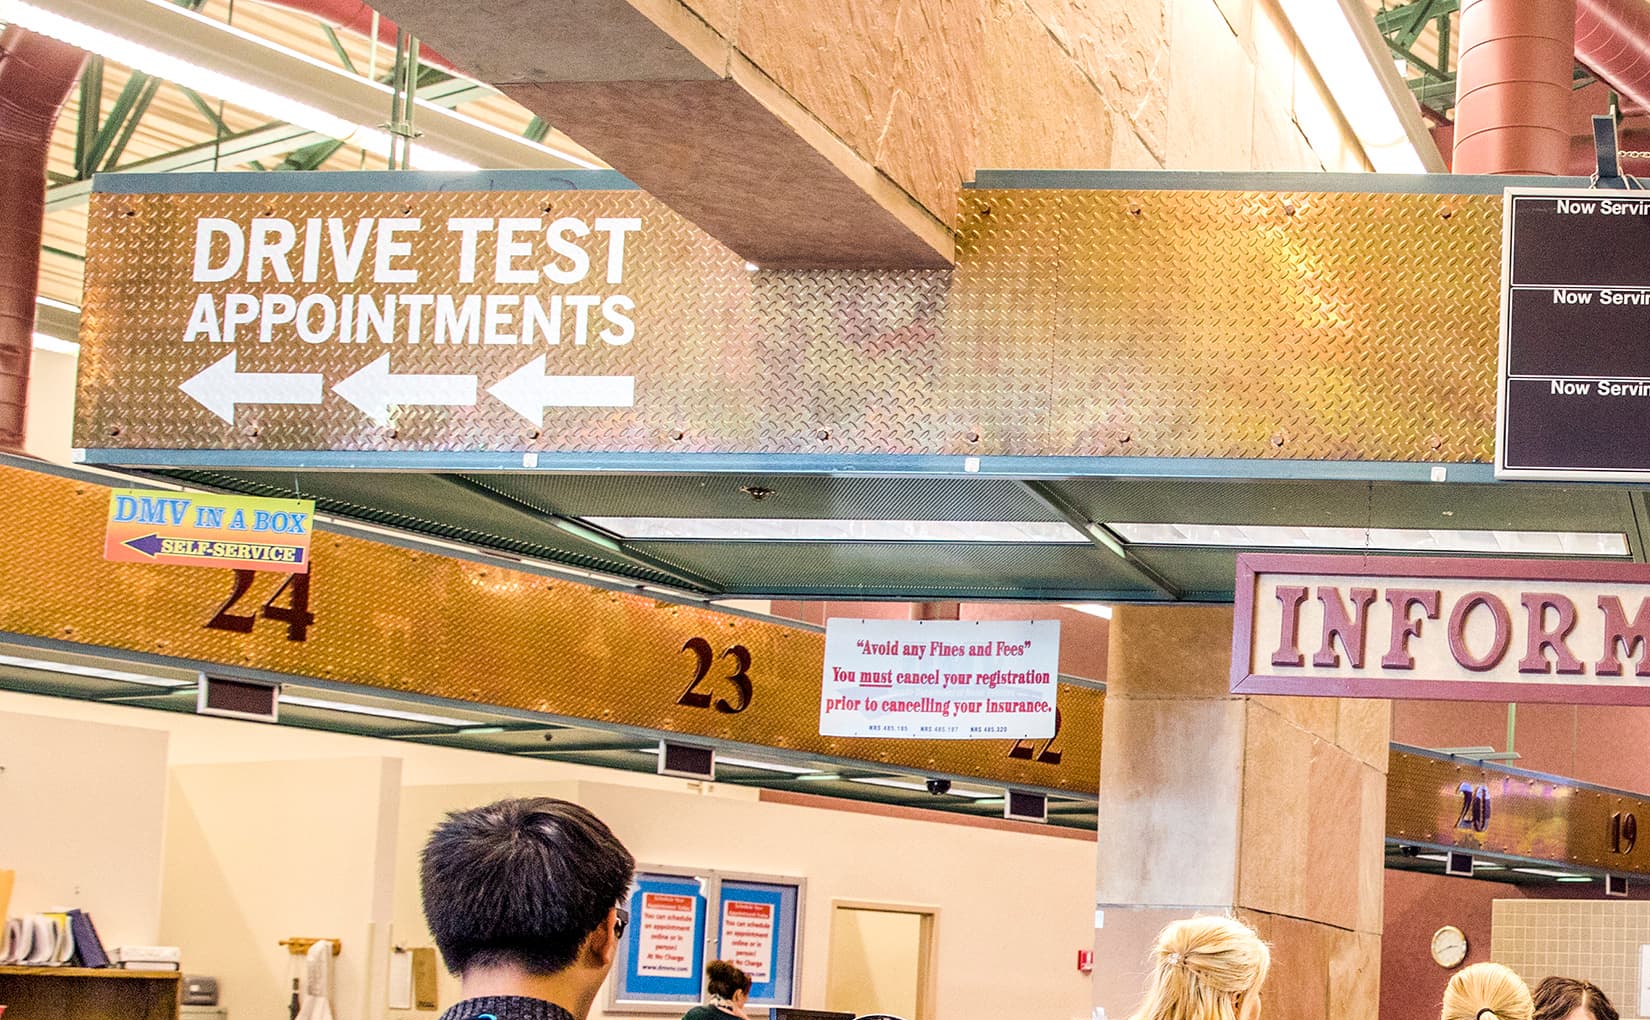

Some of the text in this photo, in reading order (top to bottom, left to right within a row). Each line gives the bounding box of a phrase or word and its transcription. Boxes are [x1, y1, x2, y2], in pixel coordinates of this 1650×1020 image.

[1557, 201, 1595, 215] Now
[192, 218, 642, 284] DRIVE TEST
[1553, 290, 1592, 304] Now
[183, 293, 636, 346] APPOINTMENTS
[1551, 381, 1590, 395] Now
[113, 496, 308, 534] DMV IN A BOX
[161, 538, 296, 562] SELF-SERVICE
[203, 562, 315, 642] 24
[903, 644, 926, 659] any
[929, 641, 965, 656] Fines
[969, 641, 993, 657] and
[676, 636, 752, 714] 23
[832, 667, 1050, 688] You must cancel your registration
[826, 696, 1052, 717] prior to cancelling your insurance.
[1455, 782, 1490, 832] 20
[1608, 811, 1637, 855] 19
[653, 924, 690, 932] appointment
[665, 954, 684, 962] Charge
